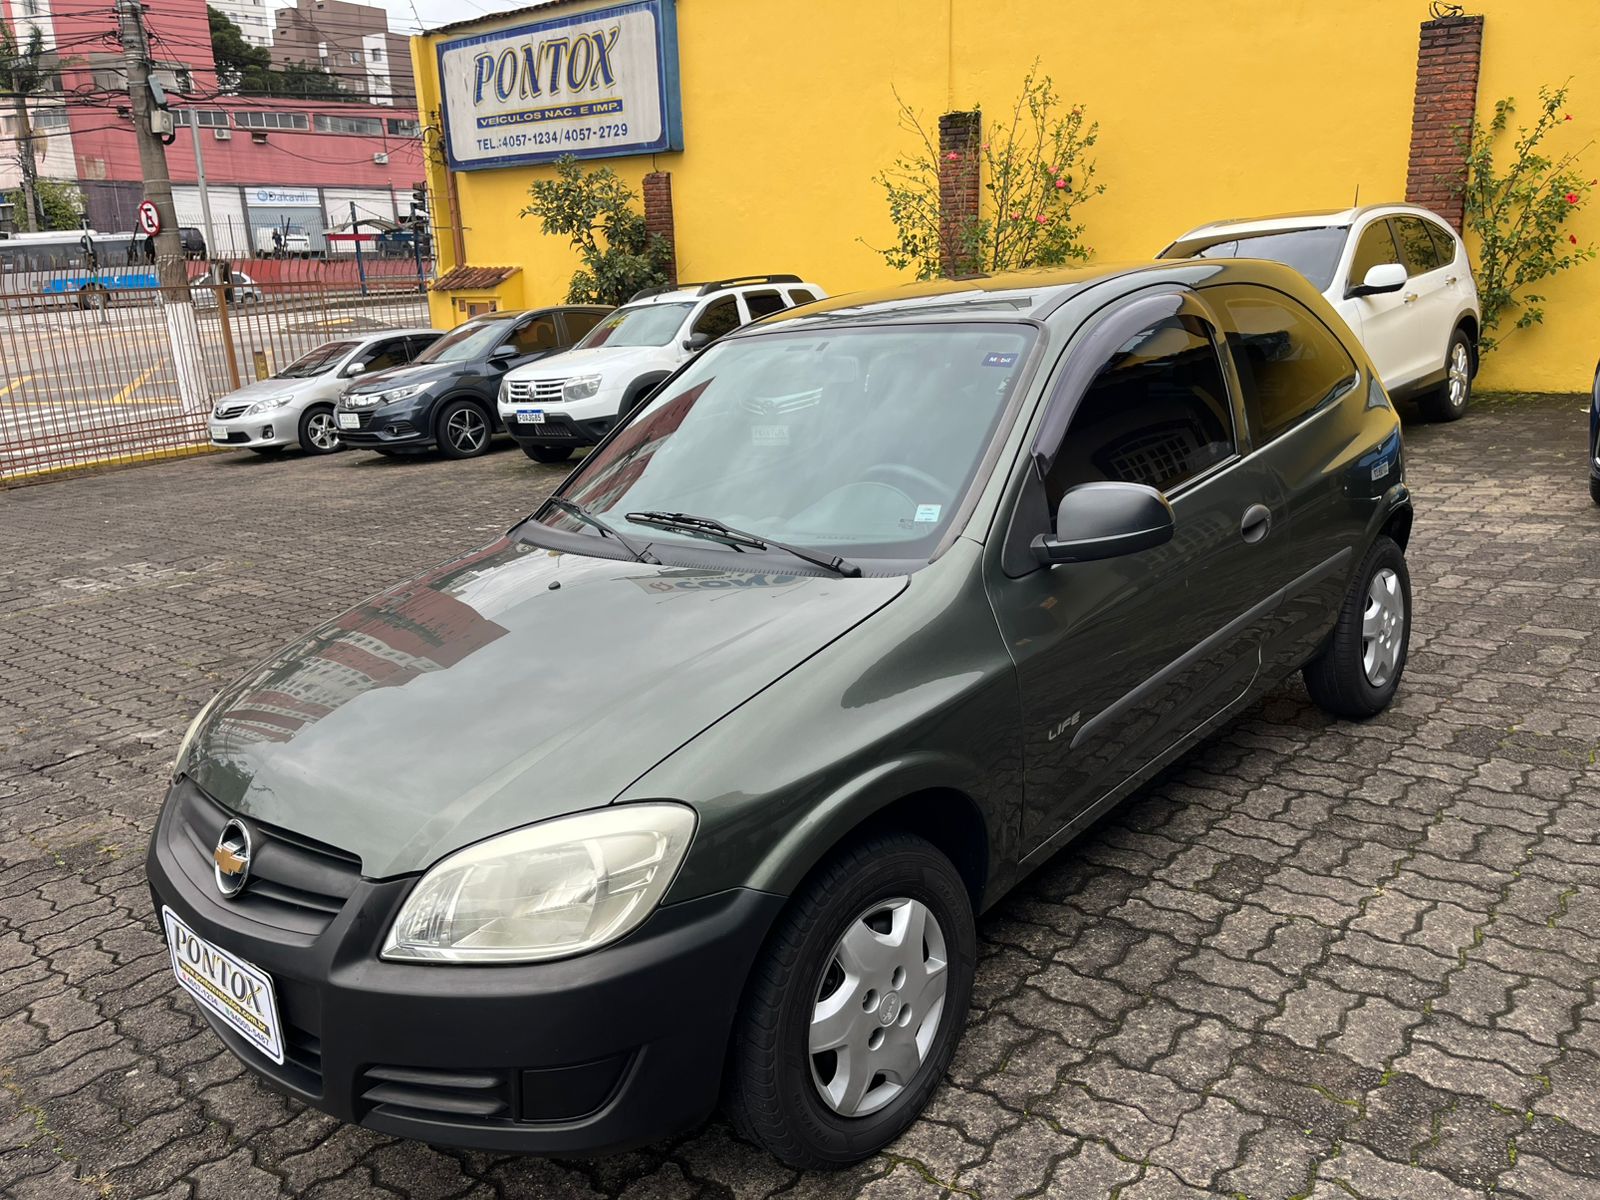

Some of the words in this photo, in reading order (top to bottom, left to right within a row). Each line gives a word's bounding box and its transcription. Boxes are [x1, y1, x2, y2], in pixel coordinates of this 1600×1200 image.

[474, 26, 621, 107] PONTOX
[545, 107, 576, 119] NAC.
[580, 105, 589, 114] E
[593, 102, 620, 113] IMP.
[1048, 711, 1081, 741] LIFE
[174, 923, 265, 1018] PONTOX
